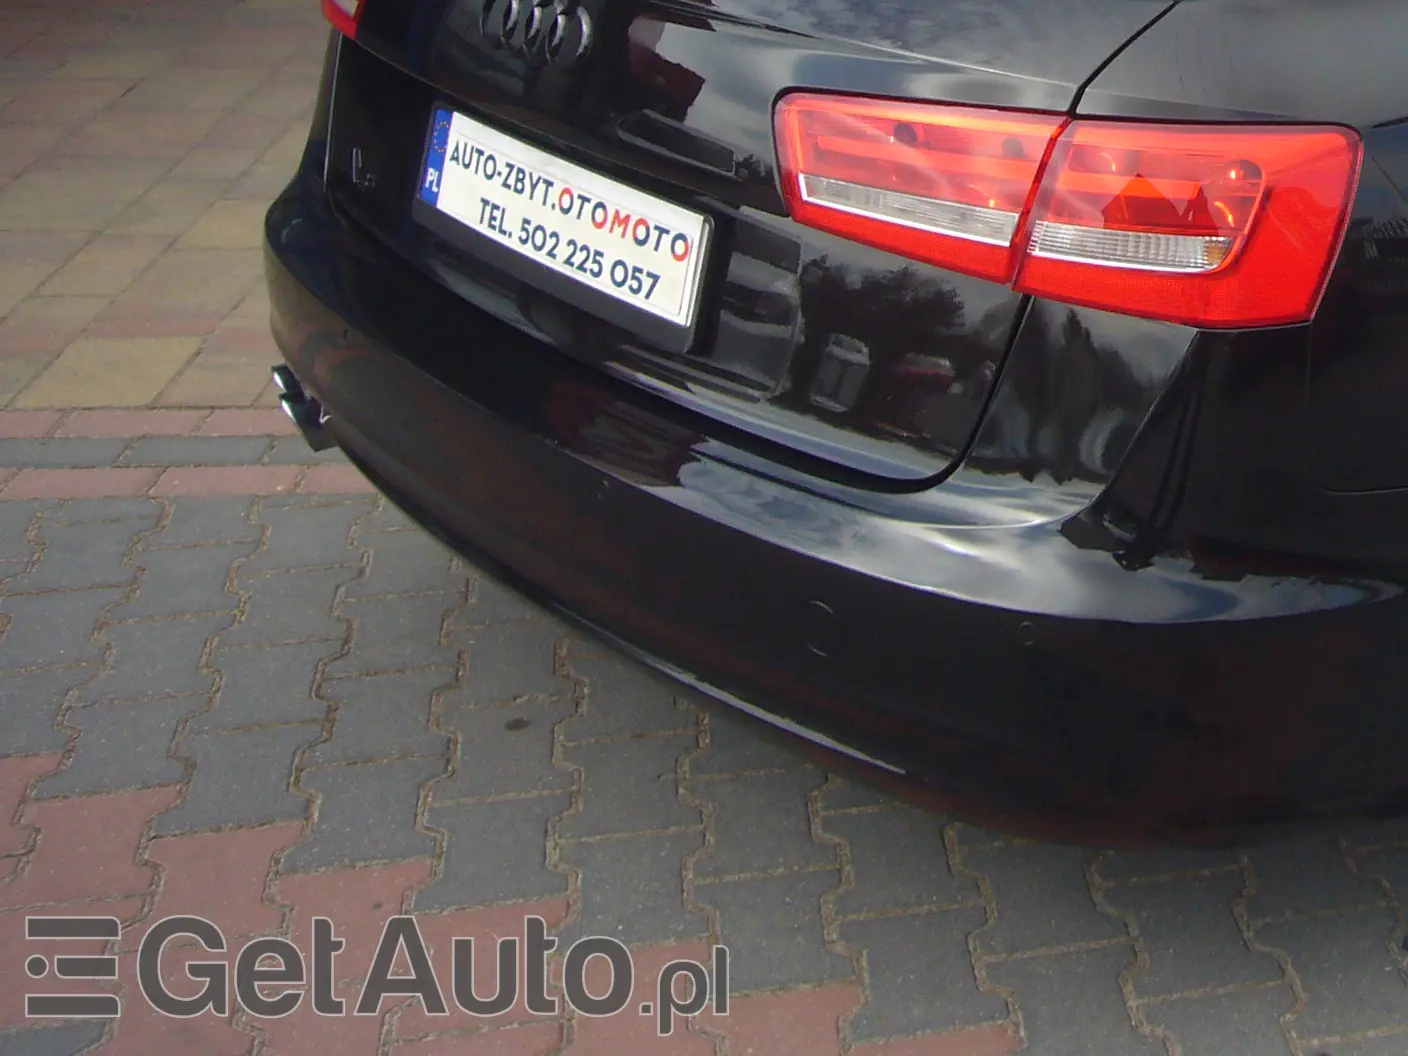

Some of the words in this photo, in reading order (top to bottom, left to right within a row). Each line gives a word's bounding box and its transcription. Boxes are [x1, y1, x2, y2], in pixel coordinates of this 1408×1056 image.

[425, 167, 440, 193] PL
[449, 139, 690, 263] AUTO-ZBYT.OTOMOTO
[479, 197, 513, 240] TEL.
[518, 217, 560, 260] 502
[562, 238, 604, 279] 225
[610, 259, 661, 300] 057
